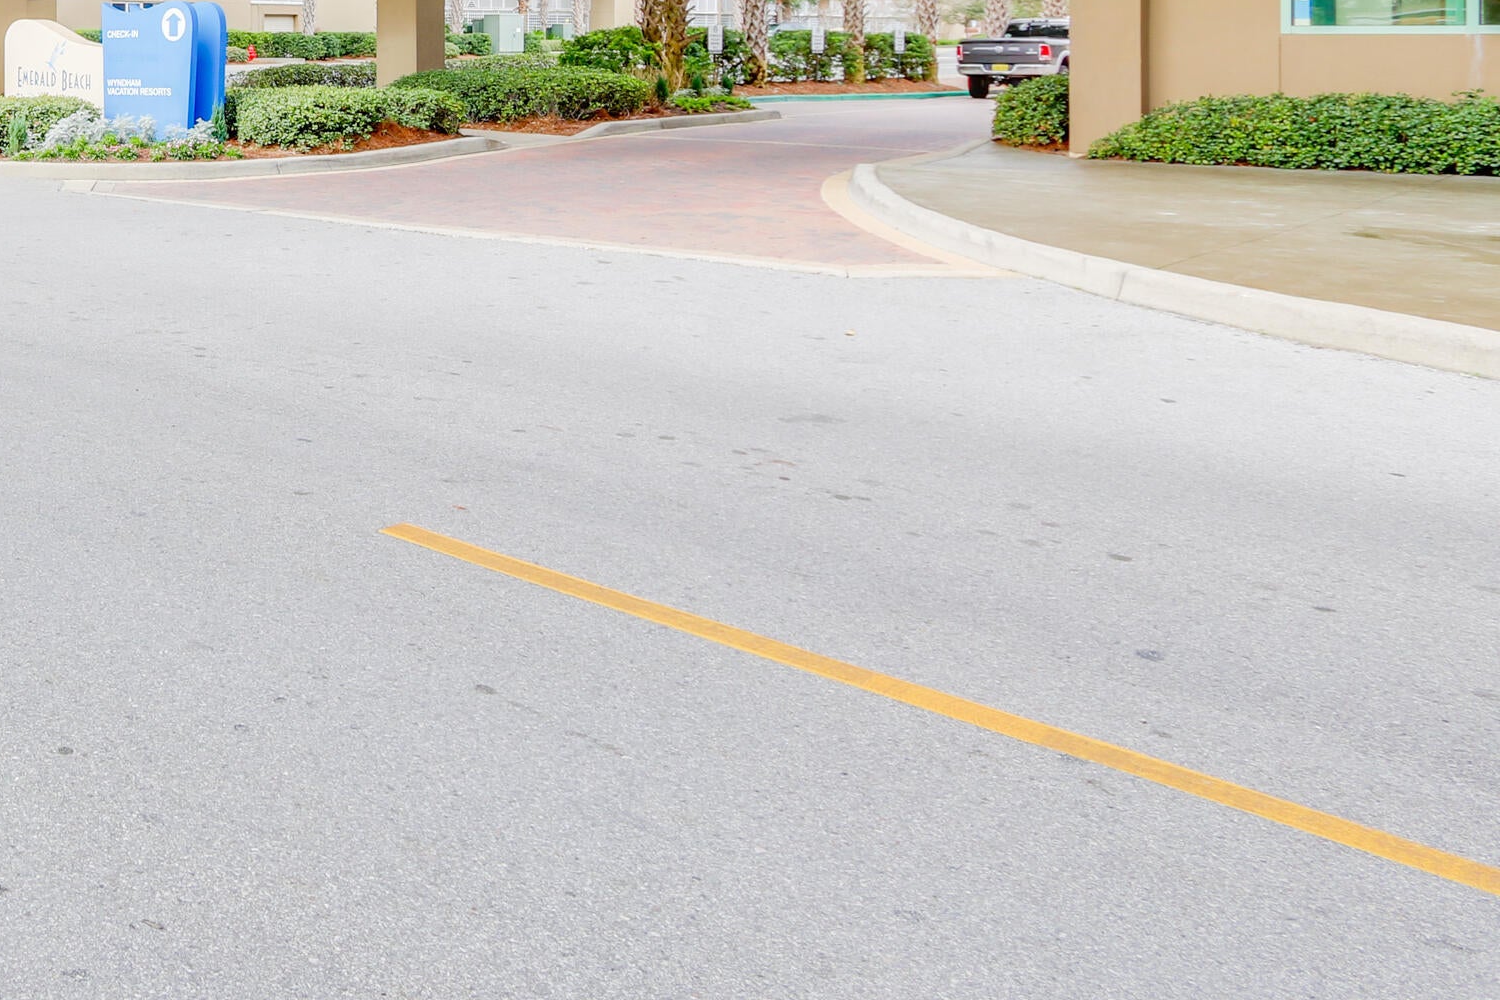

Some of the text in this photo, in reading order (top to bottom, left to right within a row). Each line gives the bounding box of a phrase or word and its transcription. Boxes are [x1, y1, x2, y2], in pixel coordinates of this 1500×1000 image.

[107, 29, 139, 39] CHECK-IN
[17, 66, 91, 91] EMERALD BEACH
[107, 78, 142, 87] WYNDHAM
[107, 87, 172, 97] VACATION RESORTS
